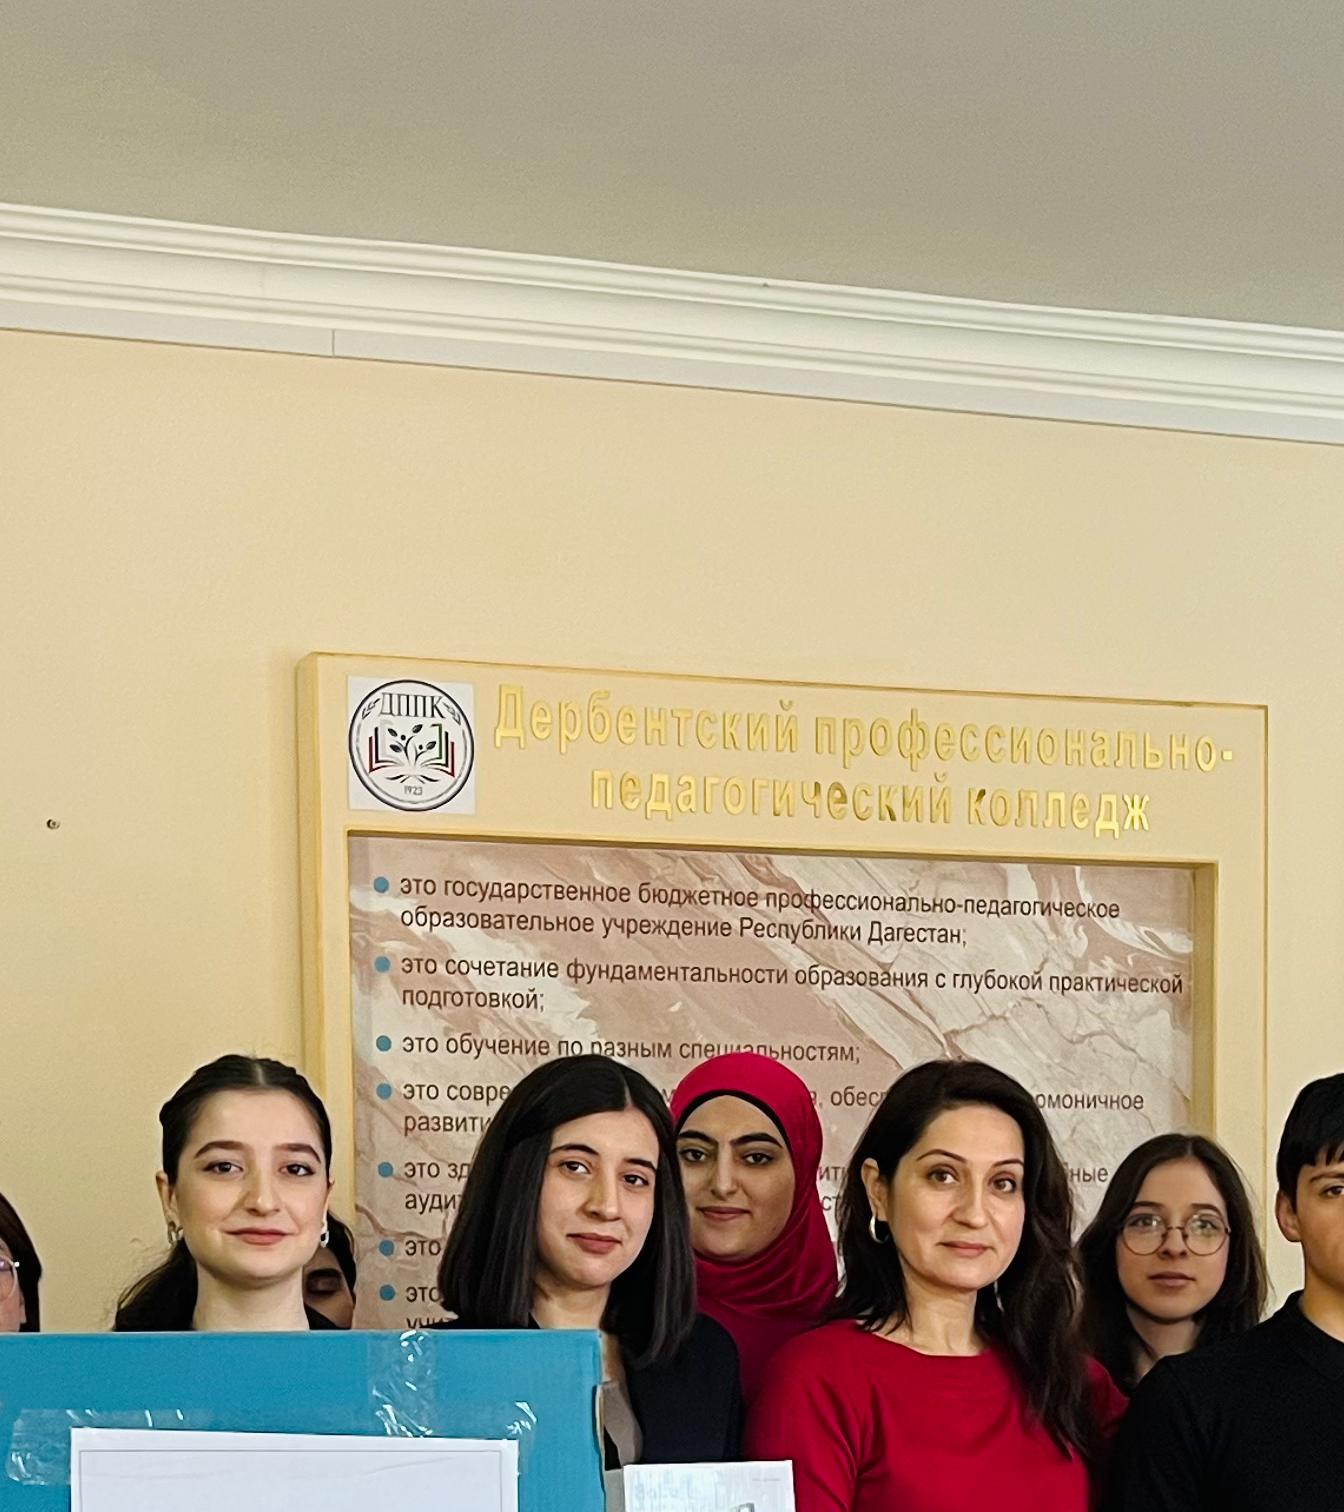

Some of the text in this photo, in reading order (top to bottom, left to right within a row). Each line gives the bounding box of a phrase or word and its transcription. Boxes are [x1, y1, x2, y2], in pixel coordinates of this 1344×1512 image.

[379, 691, 445, 719] ДППК
[493, 682, 1233, 773] Дербентский профессионально-
[403, 784, 423, 796] 1923
[591, 768, 1151, 840] педагогический колледж
[400, 877, 1121, 919] это государственное бюджетное профессионально-педагогическое
[401, 906, 967, 947] образовательное учреждение Республики Дагестан;
[401, 956, 1184, 995] это сочетание фундаментальности образования с глубокой практической
[402, 986, 545, 1012] подготовкой;
[402, 1035, 438, 1054] это
[446, 1031, 550, 1060] обучение
[557, 1039, 583, 1057] по
[590, 1041, 672, 1060] разным
[403, 1083, 439, 1101] это
[404, 1162, 440, 1179] это
[405, 1239, 441, 1256] это
[406, 1285, 440, 1304] это
